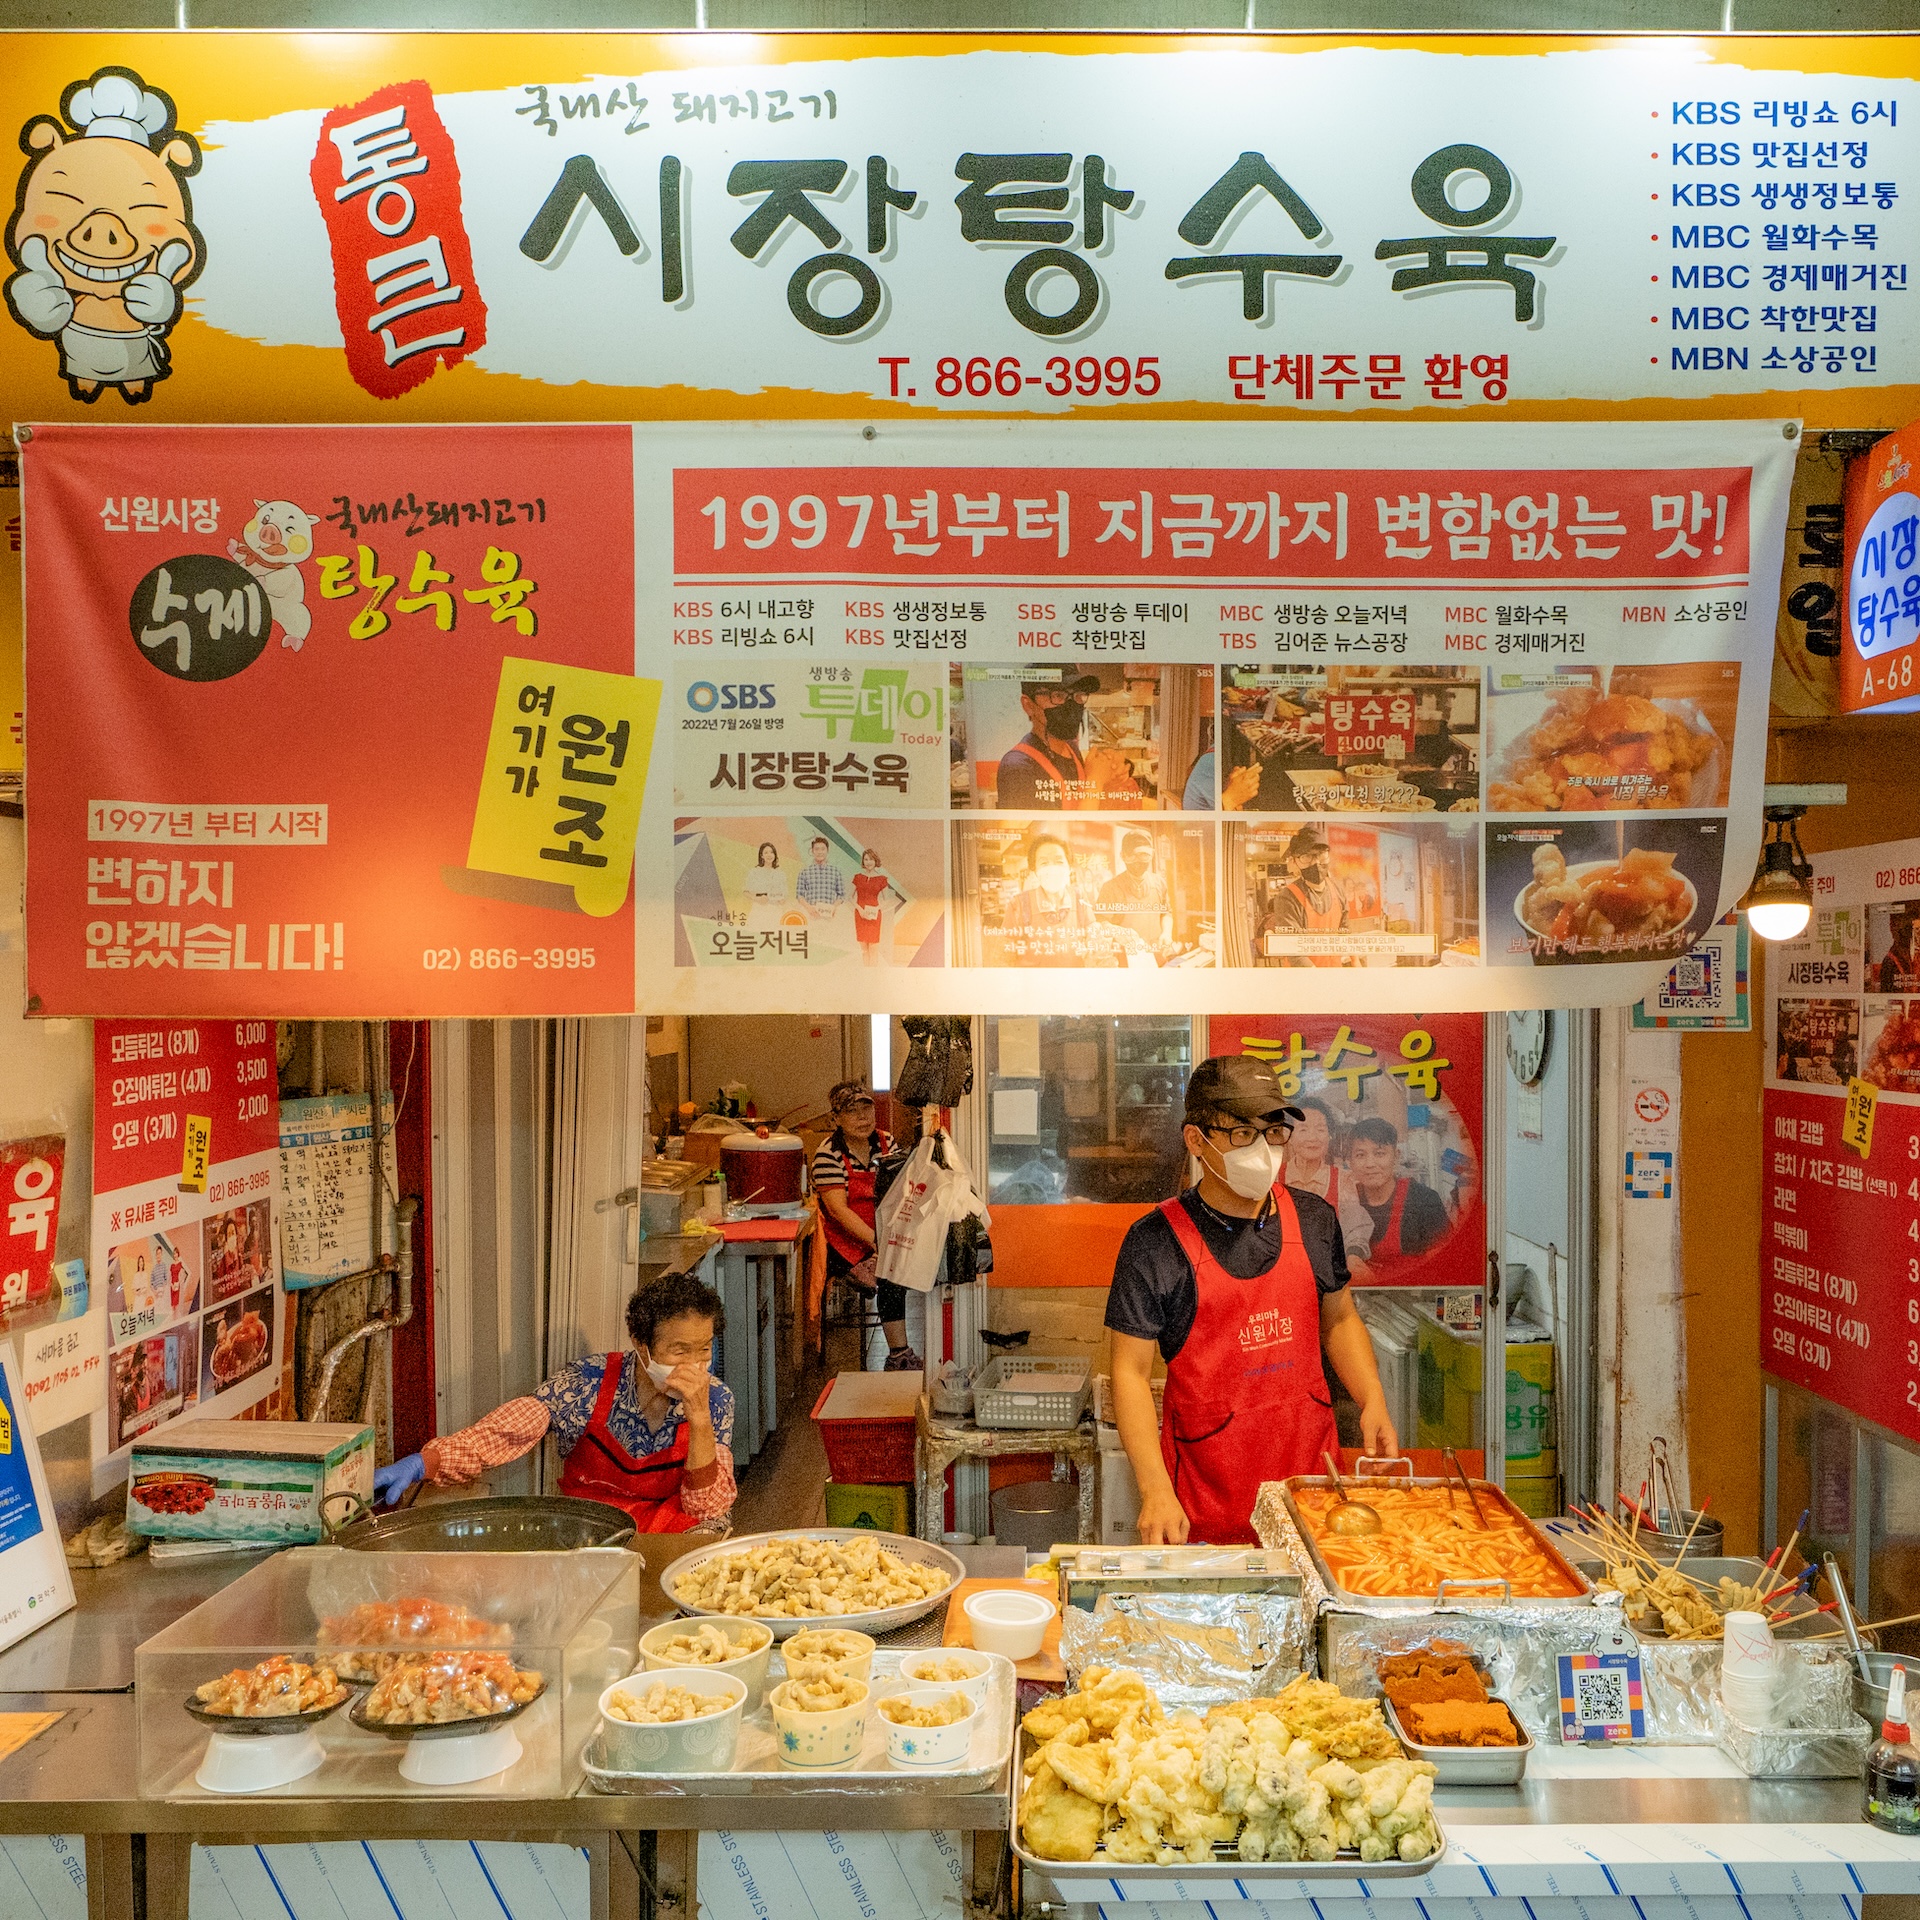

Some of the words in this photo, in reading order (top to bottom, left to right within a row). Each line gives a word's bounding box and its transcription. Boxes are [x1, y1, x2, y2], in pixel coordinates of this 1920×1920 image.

[516, 82, 649, 136] 국내산
[673, 89, 837, 123] 돼지고기
[1671, 102, 1740, 125] KBS
[1753, 100, 1840, 127] 리빙쇼
[1851, 100, 1899, 127] 6시
[1671, 143, 1740, 167] KBS
[1751, 141, 1869, 169] 맛집선정
[1671, 184, 1740, 208] KBS
[1751, 182, 1899, 210] 생생정보통
[330, 106, 467, 367] 통큰
[519, 143, 1562, 341] 시장탕수육
[1671, 225, 1750, 249] MBC
[1762, 223, 1879, 252] 월화수목
[1671, 266, 1750, 290] MBC
[1762, 264, 1908, 292] 경제매거진
[1671, 307, 1750, 331] MBC
[1761, 305, 1877, 334] 착한맛집
[1671, 348, 1749, 371] MBN
[1762, 346, 1877, 374] 소상공인
[879, 357, 916, 397] T.
[935, 357, 1160, 397] 866-3995
[1229, 354, 1406, 401] 단체주문
[1424, 354, 1509, 401] 환영
[100, 496, 220, 534] 신원시장
[700, 489, 1070, 558] 1997년부터
[1095, 489, 1349, 560] 지금까지
[1376, 491, 1627, 561] 변함없는
[1651, 491, 1729, 560] 맛!
[1862, 514, 1920, 578] 시장
[316, 545, 540, 640] 탕수육
[140, 567, 262, 672] 수제
[673, 602, 712, 618] KBS
[721, 599, 751, 620] 6시
[758, 599, 814, 621] 내고향
[845, 602, 884, 618] KBS
[893, 600, 987, 622] 생생정보통
[1018, 604, 1056, 620] SBS
[1071, 601, 1128, 623] 생방송
[1133, 601, 1189, 623] 투데이
[1220, 605, 1263, 621] MBC
[1274, 603, 1328, 625] 생방송
[1334, 603, 1407, 625] 오늘저녁
[1445, 607, 1487, 623] MBC
[1495, 604, 1567, 625] 월화수목
[1622, 607, 1666, 623] MBN
[1674, 601, 1747, 622] 소상공인
[1858, 578, 1920, 648] 탕수육
[673, 629, 712, 645] KBS
[721, 626, 778, 647] 리빙쇼
[784, 626, 814, 646] 6시
[845, 629, 884, 645] KBS
[893, 627, 967, 649] 맛집선정
[1018, 632, 1062, 648] MBC
[1072, 629, 1145, 651] 착한맛집
[1220, 634, 1257, 649] TBS
[1275, 632, 1327, 653] 김어준
[1334, 632, 1407, 653] 뉴스공장
[1445, 635, 1487, 650] MBC
[1495, 633, 1585, 654] 경제매거진
[809, 666, 853, 682] 생방송
[1861, 654, 1913, 698] A-68
[721, 684, 776, 709] SBS
[800, 683, 944, 740] 투데이
[682, 718, 718, 730] 2022년
[720, 718, 737, 730] 7월
[738, 718, 762, 731] 26일
[764, 717, 784, 730] 방영
[1330, 699, 1413, 732] 탕수육
[505, 685, 555, 797] 여기가
[901, 732, 941, 746] Today
[710, 751, 909, 793] 시장탕수육
[540, 714, 630, 868] 원조
[1292, 784, 1340, 804] 탕수육이
[1344, 784, 1368, 804] 4천
[1374, 785, 1414, 804] 원???
[93, 808, 194, 838] 1997년
[204, 810, 257, 838] 부터
[271, 811, 322, 838] 시작
[88, 857, 234, 907] 변하지
[1876, 868, 1895, 889] 02)
[710, 910, 748, 927] 생방송
[86, 921, 344, 970] 않겠습니다!
[423, 948, 459, 971] 02)
[469, 947, 596, 970] 866-3995
[709, 930, 809, 961] 오늘저녁
[1788, 960, 1849, 984] 시장탕수육
[112, 1032, 164, 1063] 모듬튀김
[167, 1028, 199, 1057] (8개)
[236, 1022, 266, 1048] 6,000
[112, 1072, 177, 1107] 오징어튀김
[181, 1066, 211, 1096] (4개)
[237, 1058, 267, 1085] 3,500
[112, 1120, 139, 1151] 오뎅
[143, 1112, 177, 1144] (3개)
[238, 1094, 268, 1122] 2,000
[1775, 1115, 1797, 1141] 야채
[1800, 1122, 1824, 1146] 김밥
[210, 1181, 225, 1203] 02)
[228, 1170, 271, 1197] 866-3995
[1637, 1169, 1660, 1177] zero
[1774, 1151, 1797, 1177] 참치
[1809, 1159, 1834, 1186] 치즈
[1837, 1163, 1863, 1193] 김밥
[125, 1201, 156, 1228] 유사품
[159, 1195, 178, 1217] 주의
[1774, 1186, 1797, 1213] 라면
[1774, 1220, 1808, 1252] 떡볶이
[1773, 1256, 1820, 1293] 모듬튀김
[1823, 1271, 1858, 1307] (8개)
[119, 1307, 155, 1336] 오늘저녁
[1238, 1316, 1293, 1345] 신원시장
[1773, 1291, 1832, 1335] 오징어튀김
[1836, 1313, 1870, 1350] (4개)
[1772, 1327, 1796, 1356] 오뎅
[1799, 1336, 1831, 1372] (3개)
[218, 1492, 287, 1511] 방울토마토
[1607, 1728, 1628, 1736] zero
[63, 1856, 87, 1890] STEEL
[731, 1854, 768, 1916] STAINLESS
[839, 1857, 876, 1918] STAINLESS
